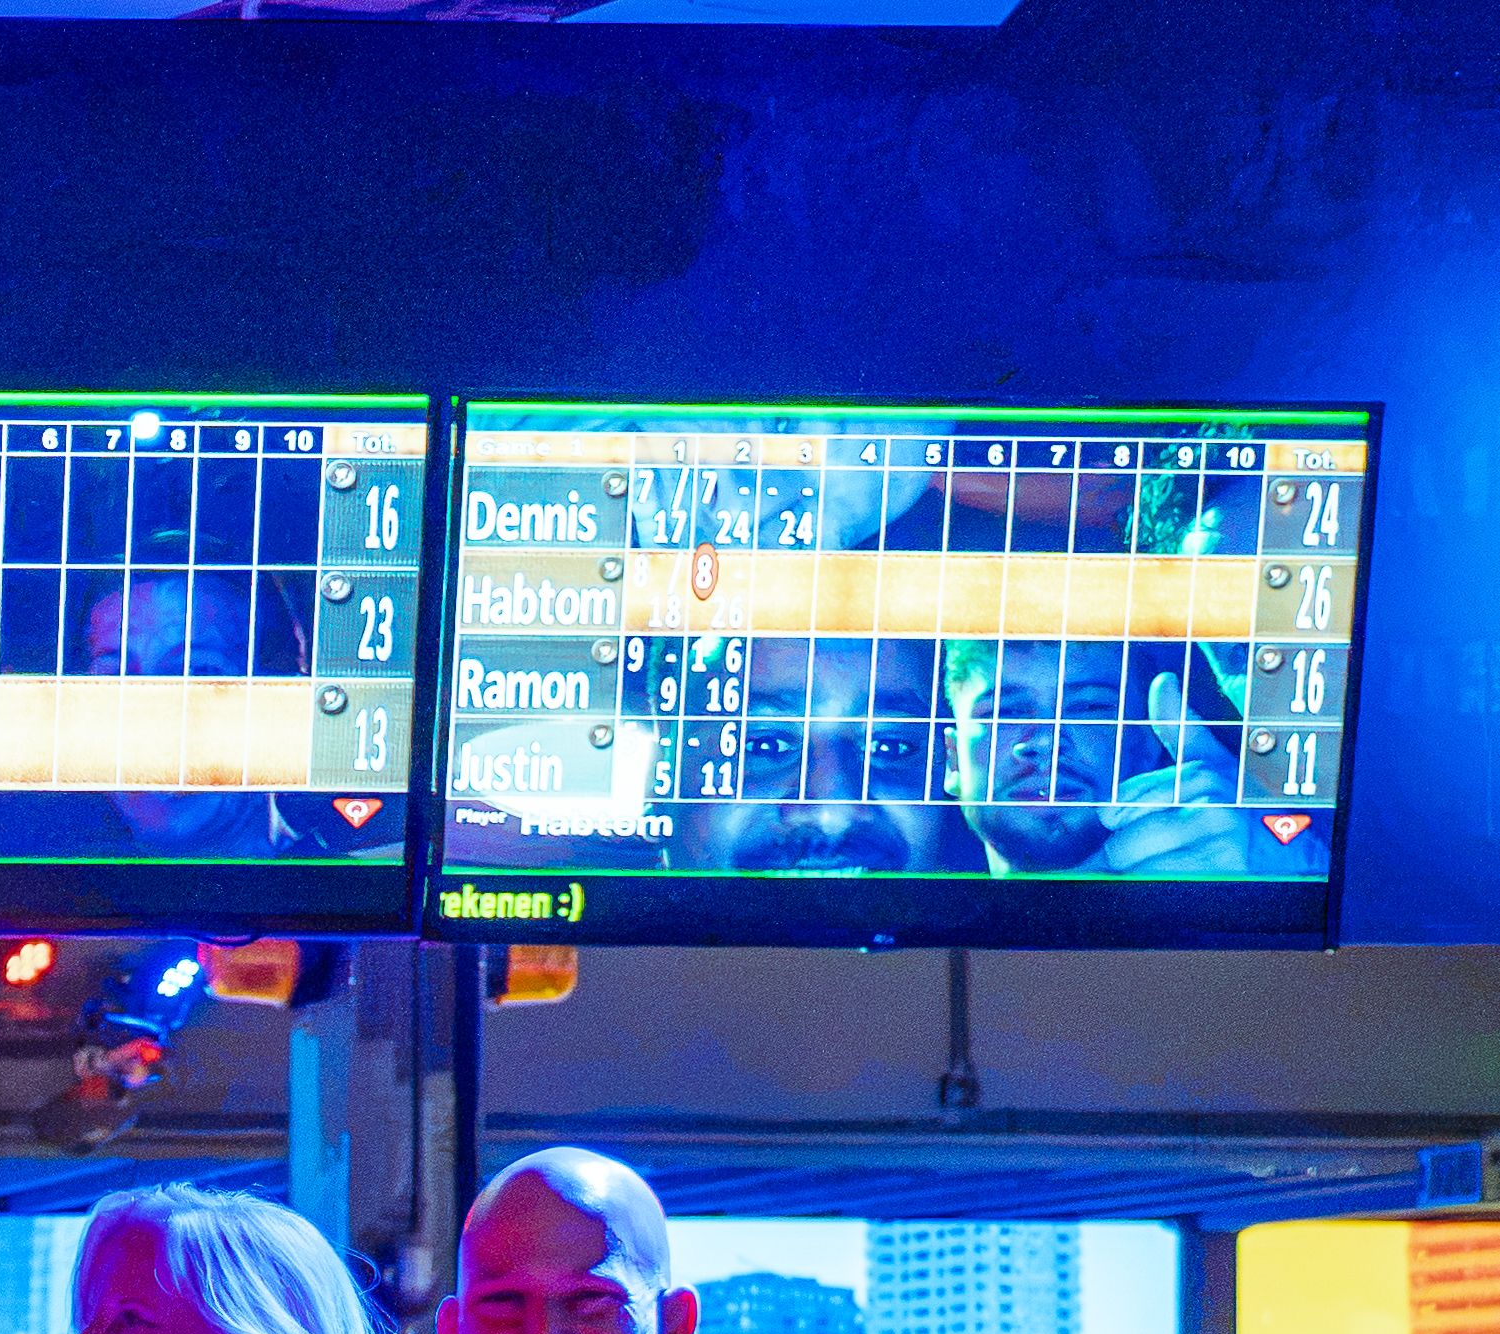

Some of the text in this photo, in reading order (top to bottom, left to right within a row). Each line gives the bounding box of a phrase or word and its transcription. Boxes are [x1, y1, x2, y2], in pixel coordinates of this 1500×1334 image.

[41, 429, 58, 449] 6
[105, 430, 121, 450] 7
[169, 430, 185, 450] 8
[234, 430, 250, 450] 9
[284, 430, 313, 451] 10
[673, 441, 1337, 470] 1 2 3 4 5 6 7 8 9 10 Tot.
[638, 470, 718, 505] 7 7
[365, 484, 400, 550] 16
[466, 490, 598, 542] Dennis
[652, 509, 813, 545] 17 24 24
[1303, 482, 1339, 546] 24
[696, 554, 714, 590] 8
[1295, 565, 1331, 631] 26
[461, 572, 617, 626] Habtom
[357, 596, 394, 662] 23
[627, 638, 742, 673] 9 6
[1290, 649, 1325, 714] 16
[458, 658, 590, 710] Ramon
[660, 677, 740, 712] 9 16
[353, 706, 388, 772] 13
[720, 721, 737, 756] 6
[1283, 732, 1317, 796] 11
[453, 740, 563, 793] Justin
[654, 761, 734, 795] 5 11
[455, 809, 673, 837] Player Habtom
